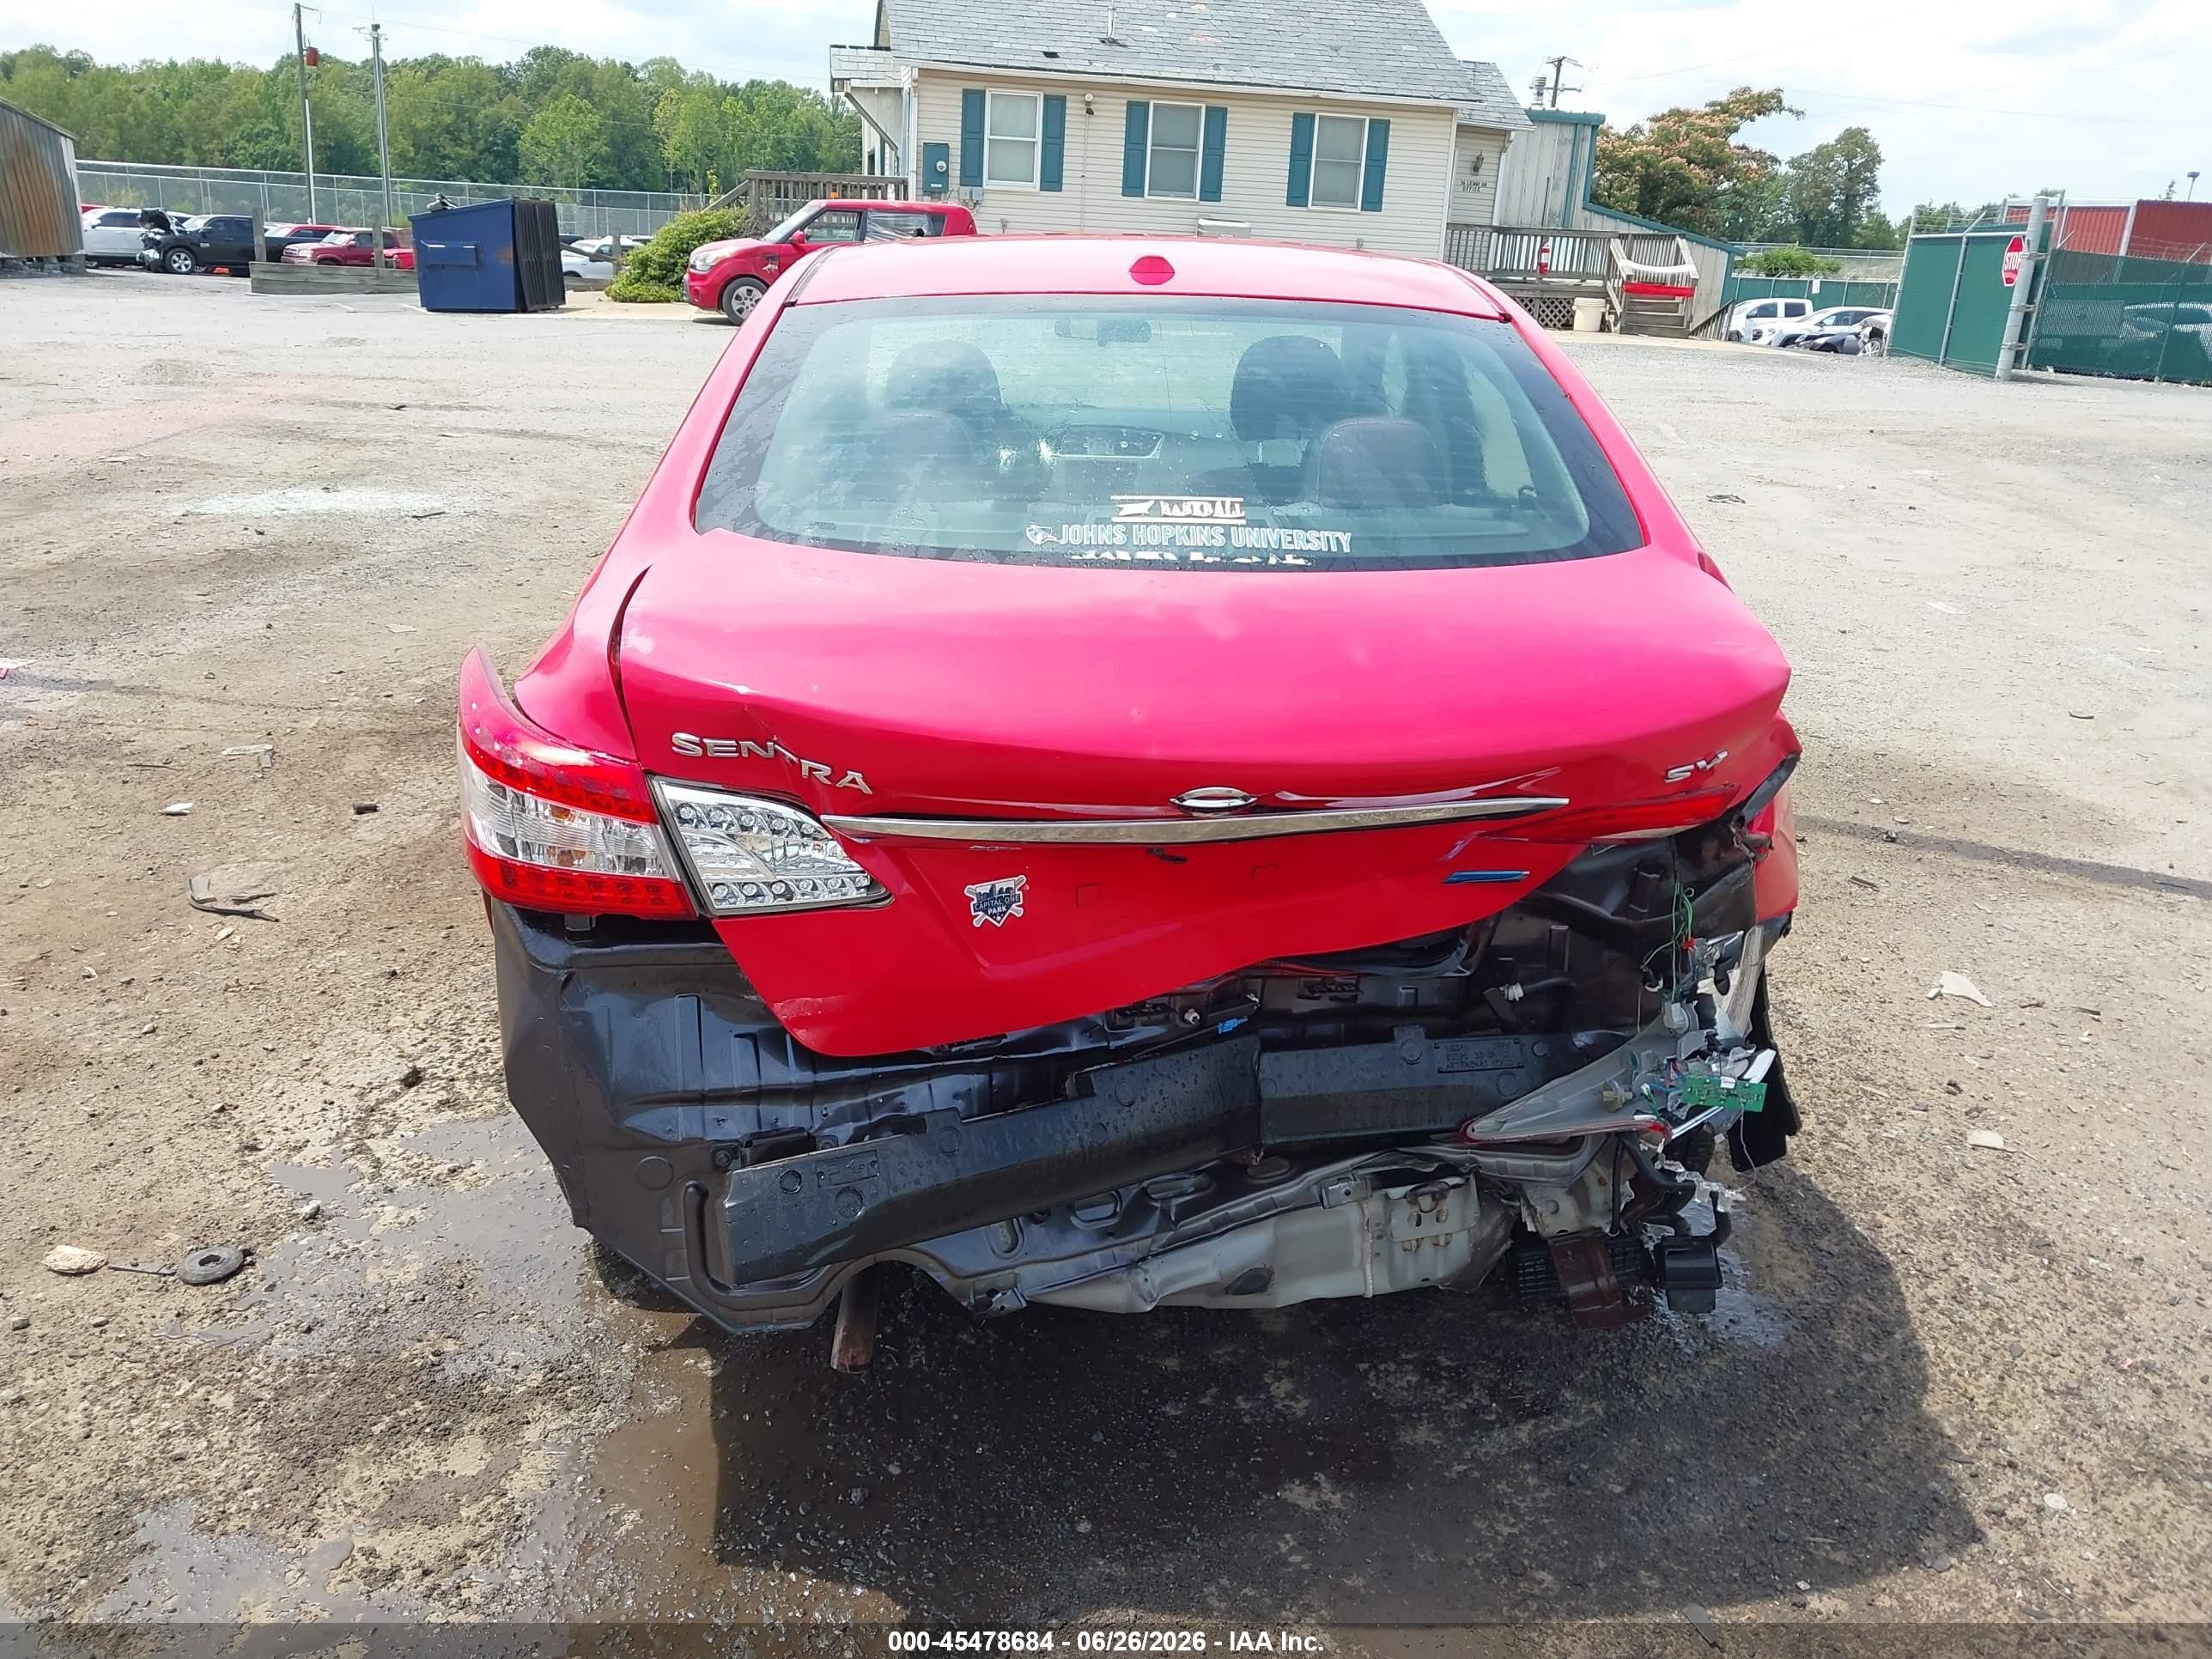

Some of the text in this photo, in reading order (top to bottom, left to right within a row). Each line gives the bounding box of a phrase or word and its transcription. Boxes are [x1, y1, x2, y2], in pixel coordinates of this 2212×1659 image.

[1059, 524, 1352, 553] JOHNS HOPKINS UNIVERSITY
[671, 732, 873, 794] SENTRA
[1663, 750, 1729, 783] SV
[975, 895, 1019, 910] CAPITAL ONE
[988, 905, 1007, 915] PARK
